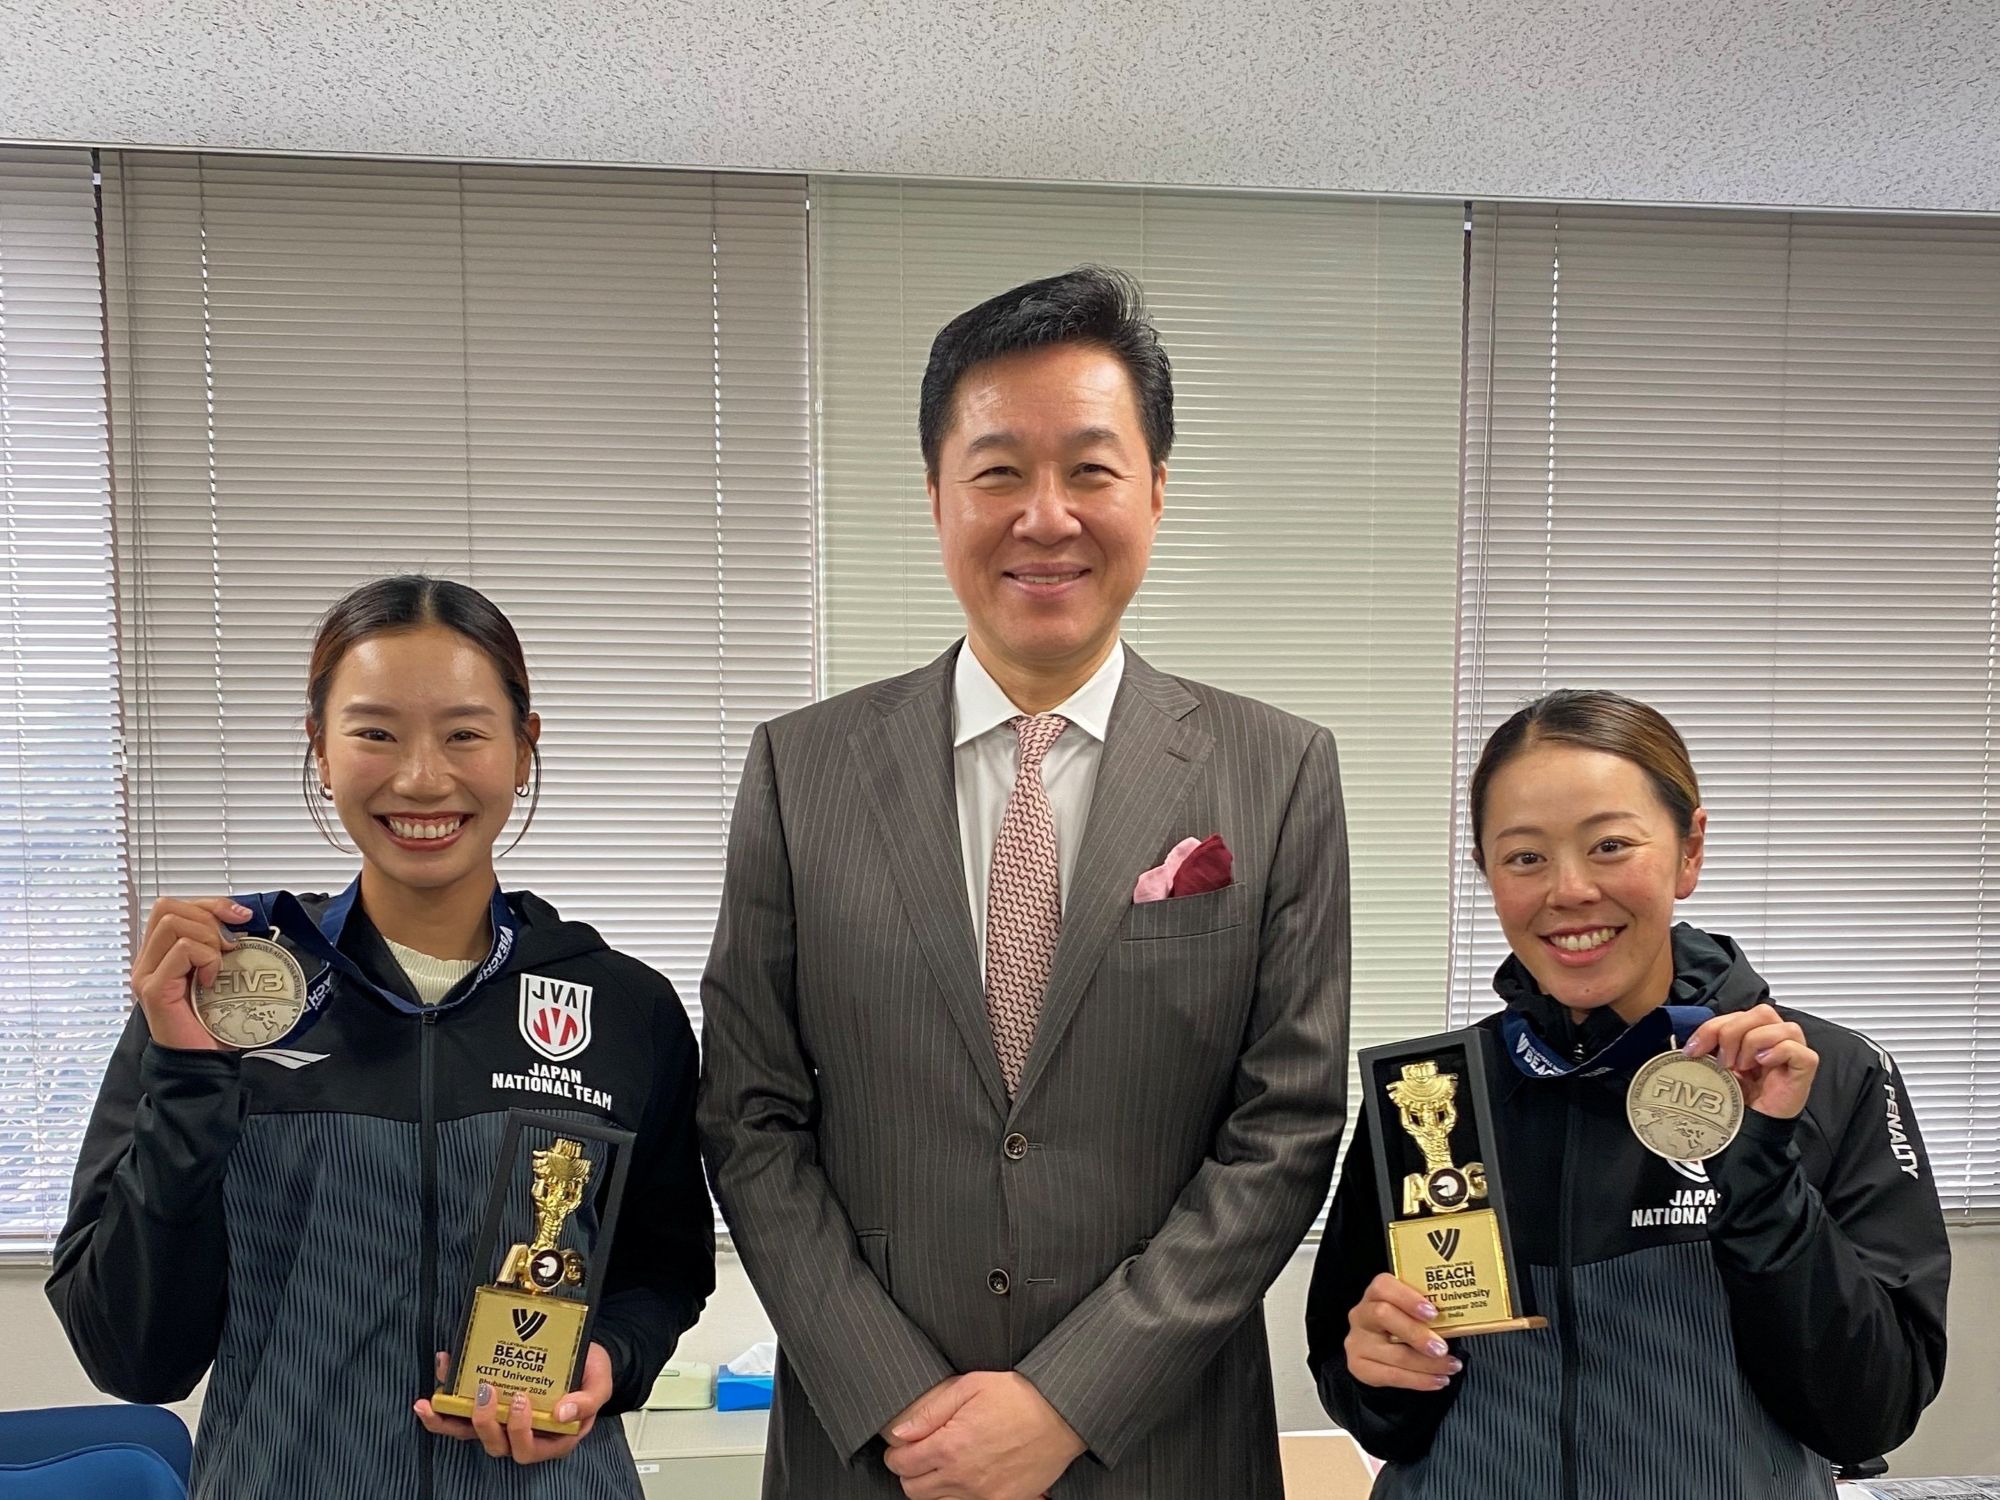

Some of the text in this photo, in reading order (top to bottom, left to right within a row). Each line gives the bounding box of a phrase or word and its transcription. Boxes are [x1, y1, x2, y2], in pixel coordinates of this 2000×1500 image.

[214, 970, 285, 993] FIVB
[532, 980, 578, 1009] JVA
[528, 1063, 582, 1084] JAPAN
[492, 1073, 613, 1111] NATIONAL TEAM
[1652, 1075, 1724, 1114] FIVB
[1884, 1084, 1919, 1179] PENALTY
[1668, 1189, 1721, 1206] JAPA
[1631, 1207, 1714, 1227] NATIONA
[1426, 1265, 1475, 1282] BEACH
[1427, 1278, 1476, 1291] PRO TOUR
[1441, 1289, 1490, 1302] University
[494, 1344, 548, 1364] BEACH
[492, 1357, 544, 1373] PRO TOUR
[476, 1365, 555, 1388] KIIT University
[529, 1386, 547, 1395] 2026
